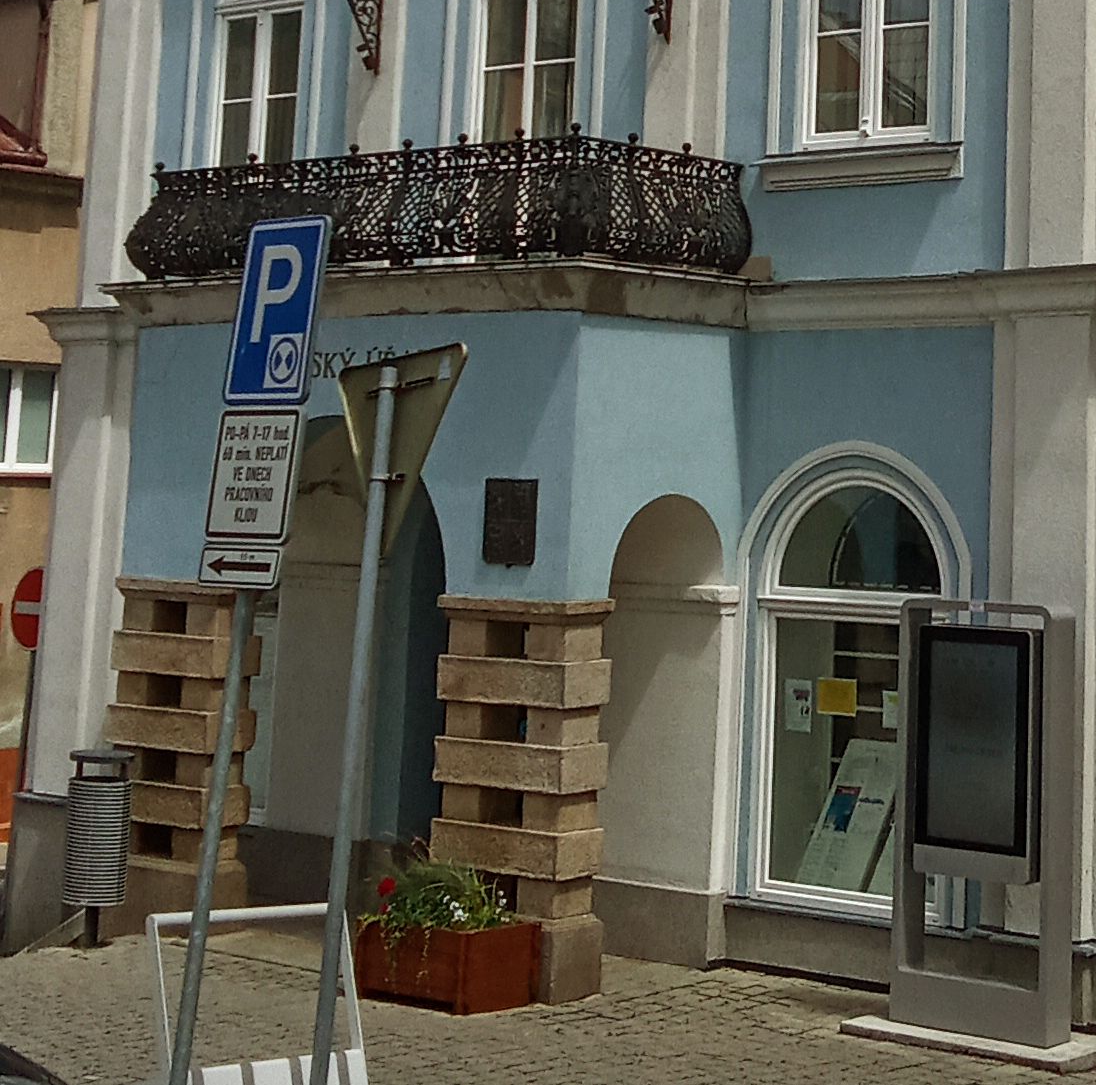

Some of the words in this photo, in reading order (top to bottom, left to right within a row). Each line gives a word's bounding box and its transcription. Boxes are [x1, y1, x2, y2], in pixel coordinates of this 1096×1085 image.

[250, 244, 303, 343] P
[255, 442, 289, 461] NEPLATÍ
[233, 466, 244, 482] VE
[245, 466, 272, 482] DNECH
